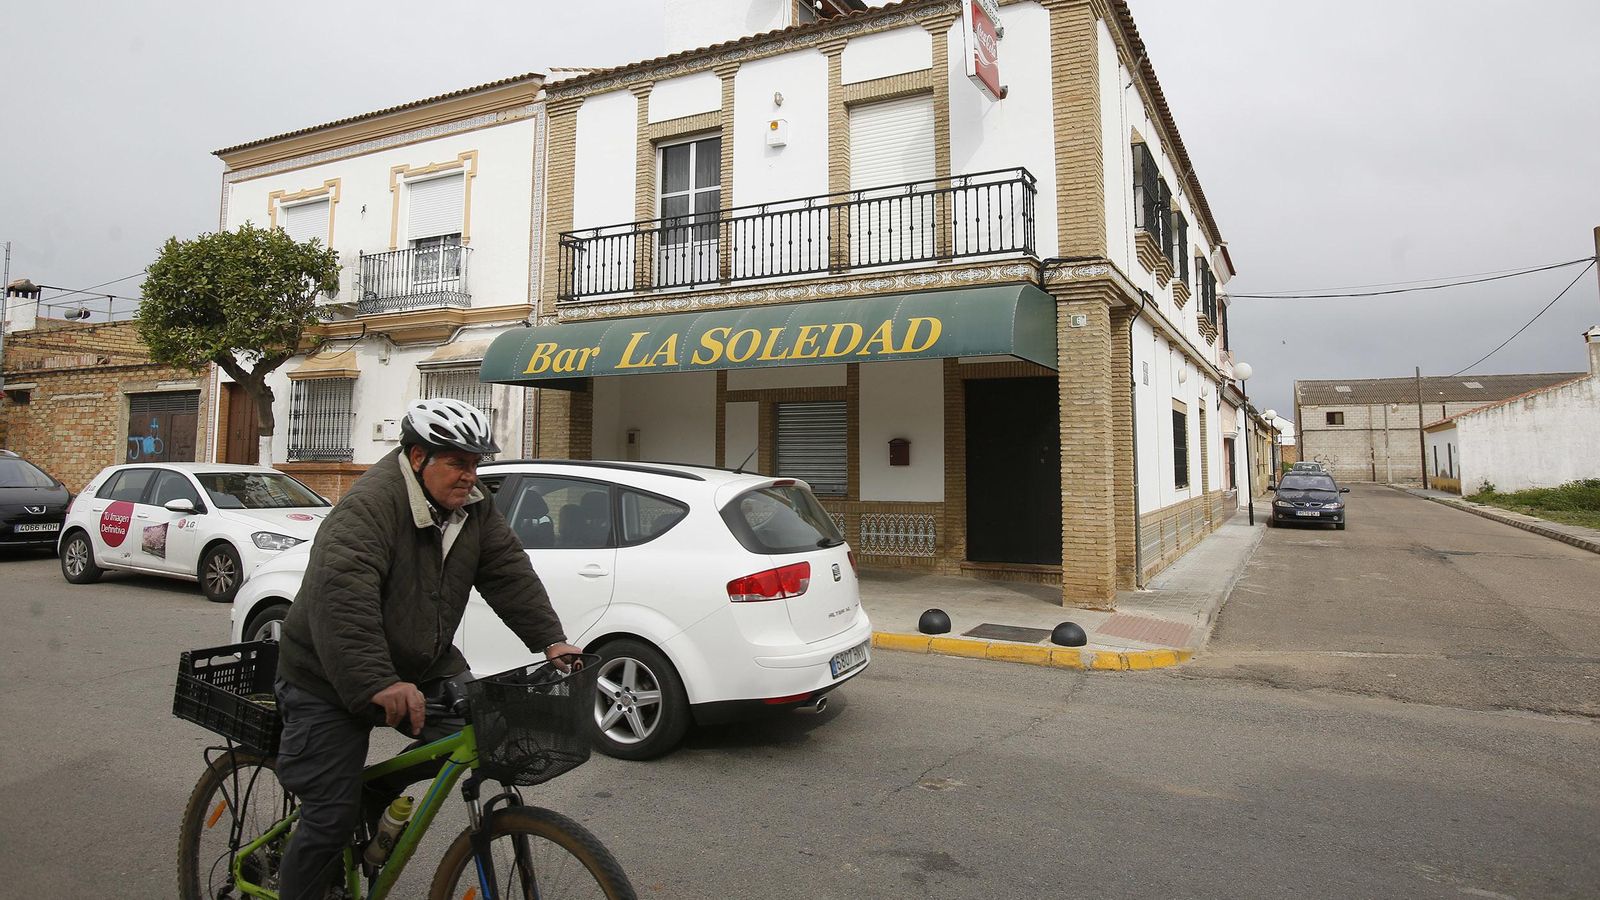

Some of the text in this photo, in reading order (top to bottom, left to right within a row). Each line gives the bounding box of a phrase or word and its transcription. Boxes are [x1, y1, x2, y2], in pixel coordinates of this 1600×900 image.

[523, 317, 943, 376] Bar LA SOLEDAD
[110, 512, 130, 524] Imagen
[101, 523, 126, 535] Definitiva
[836, 649, 852, 670] 6807
